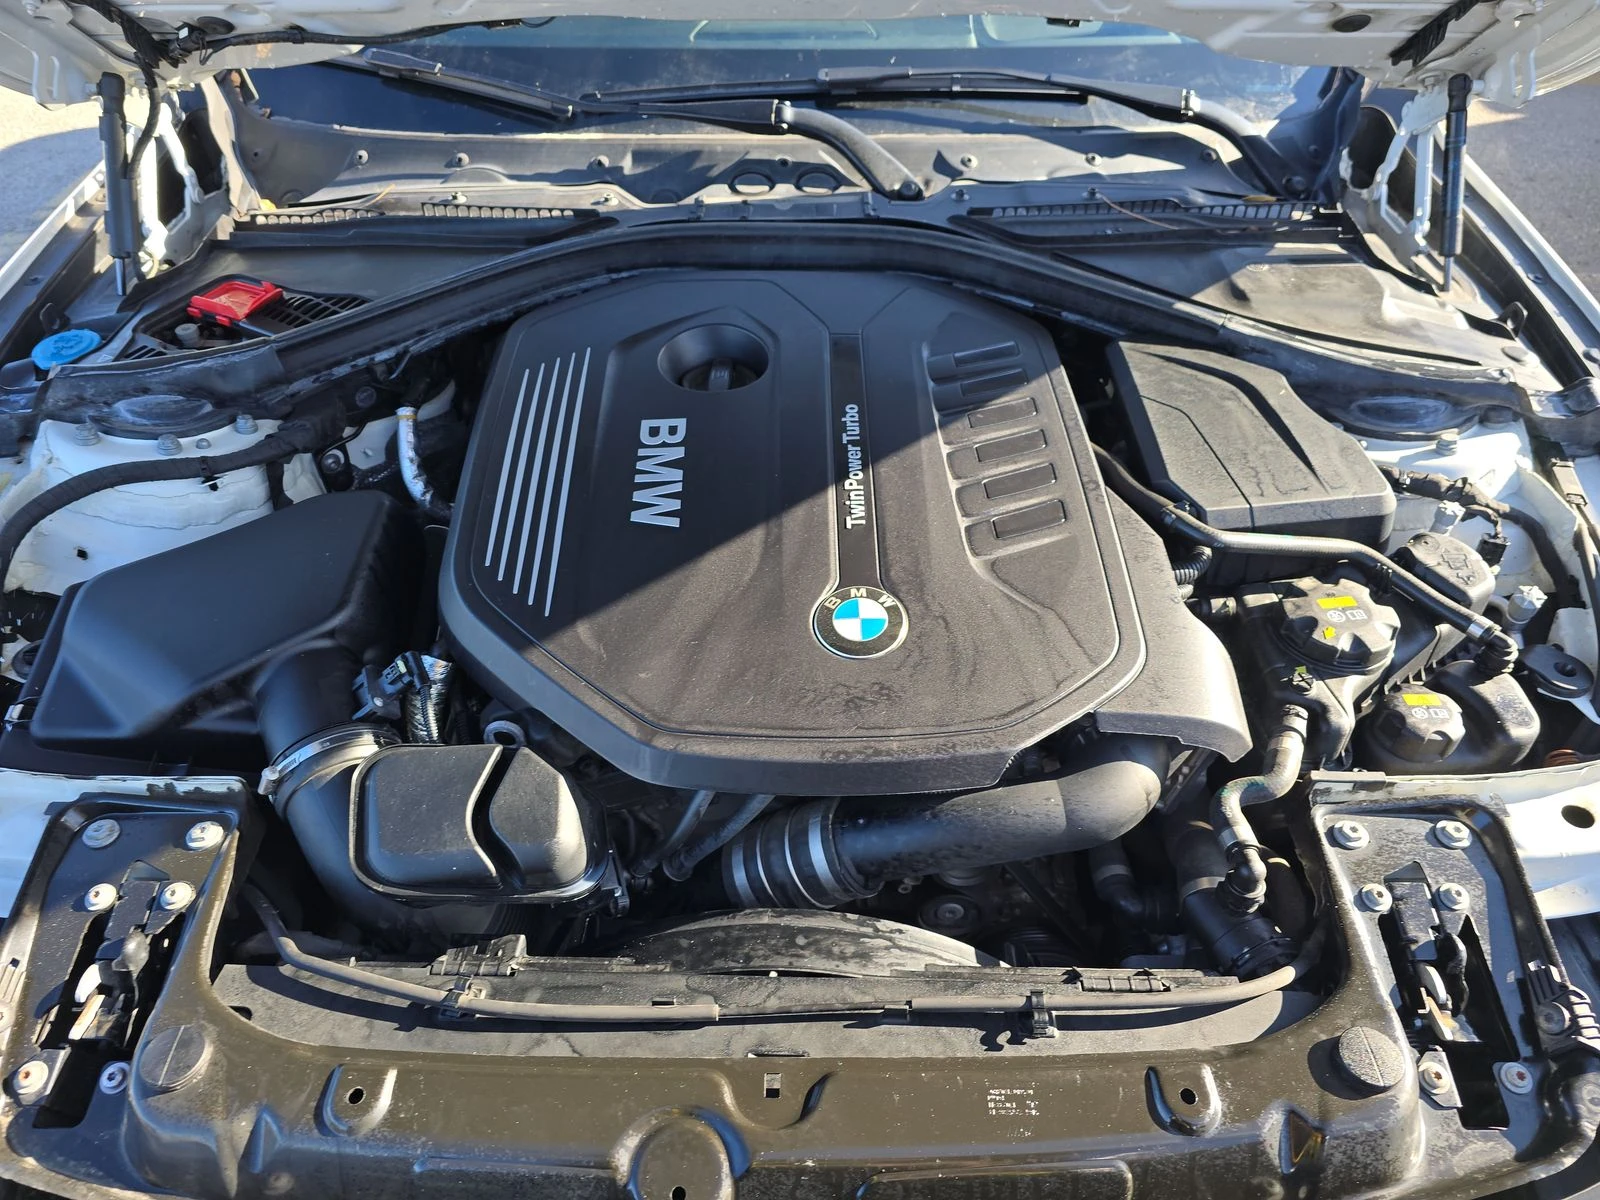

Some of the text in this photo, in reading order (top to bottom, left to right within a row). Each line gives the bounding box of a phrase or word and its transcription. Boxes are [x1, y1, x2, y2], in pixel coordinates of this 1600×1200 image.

[630, 418, 687, 528] BMW
[841, 404, 866, 529] TwinPower Turbo
[823, 588, 896, 610] BMW
